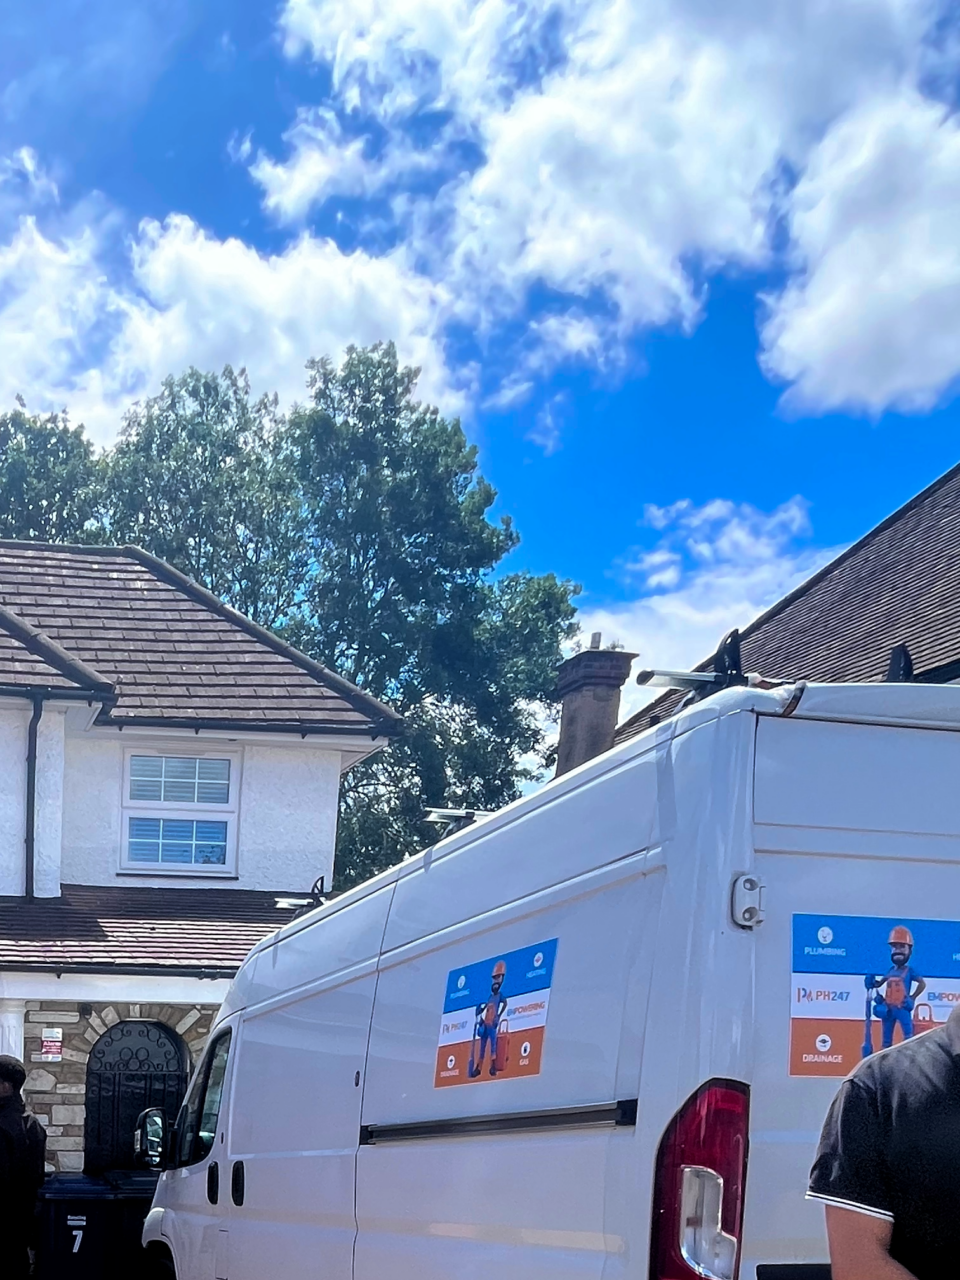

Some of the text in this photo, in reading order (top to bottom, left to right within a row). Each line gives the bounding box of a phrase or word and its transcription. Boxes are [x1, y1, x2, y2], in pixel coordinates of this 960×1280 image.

[804, 947, 846, 956] PLUMBING
[815, 990, 850, 1001] PH247
[507, 1001, 545, 1016] EMPOWERING
[803, 1054, 843, 1063] DRAINAGE
[73, 1230, 83, 1253] 7
